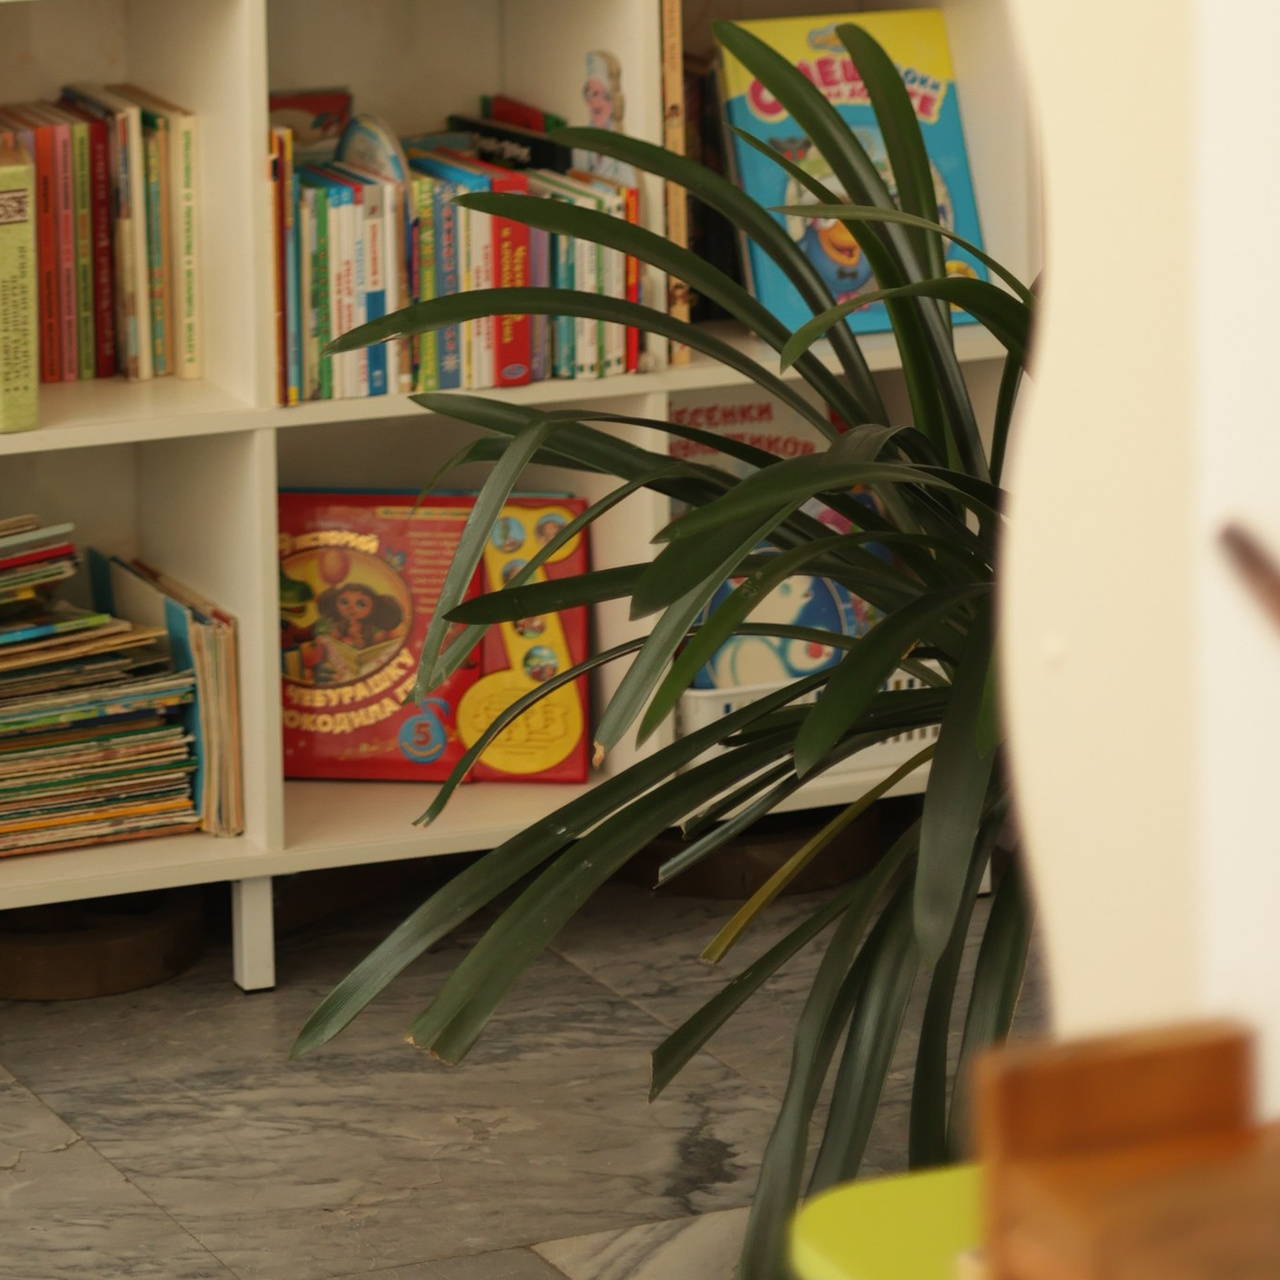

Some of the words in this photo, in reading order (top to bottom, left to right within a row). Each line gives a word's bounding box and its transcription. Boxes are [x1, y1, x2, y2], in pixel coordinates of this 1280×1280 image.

[669, 401, 773, 429] ЕСЕНКИ
[283, 698, 402, 734] ОКОДИЛА
[413, 720, 433, 746] 5
